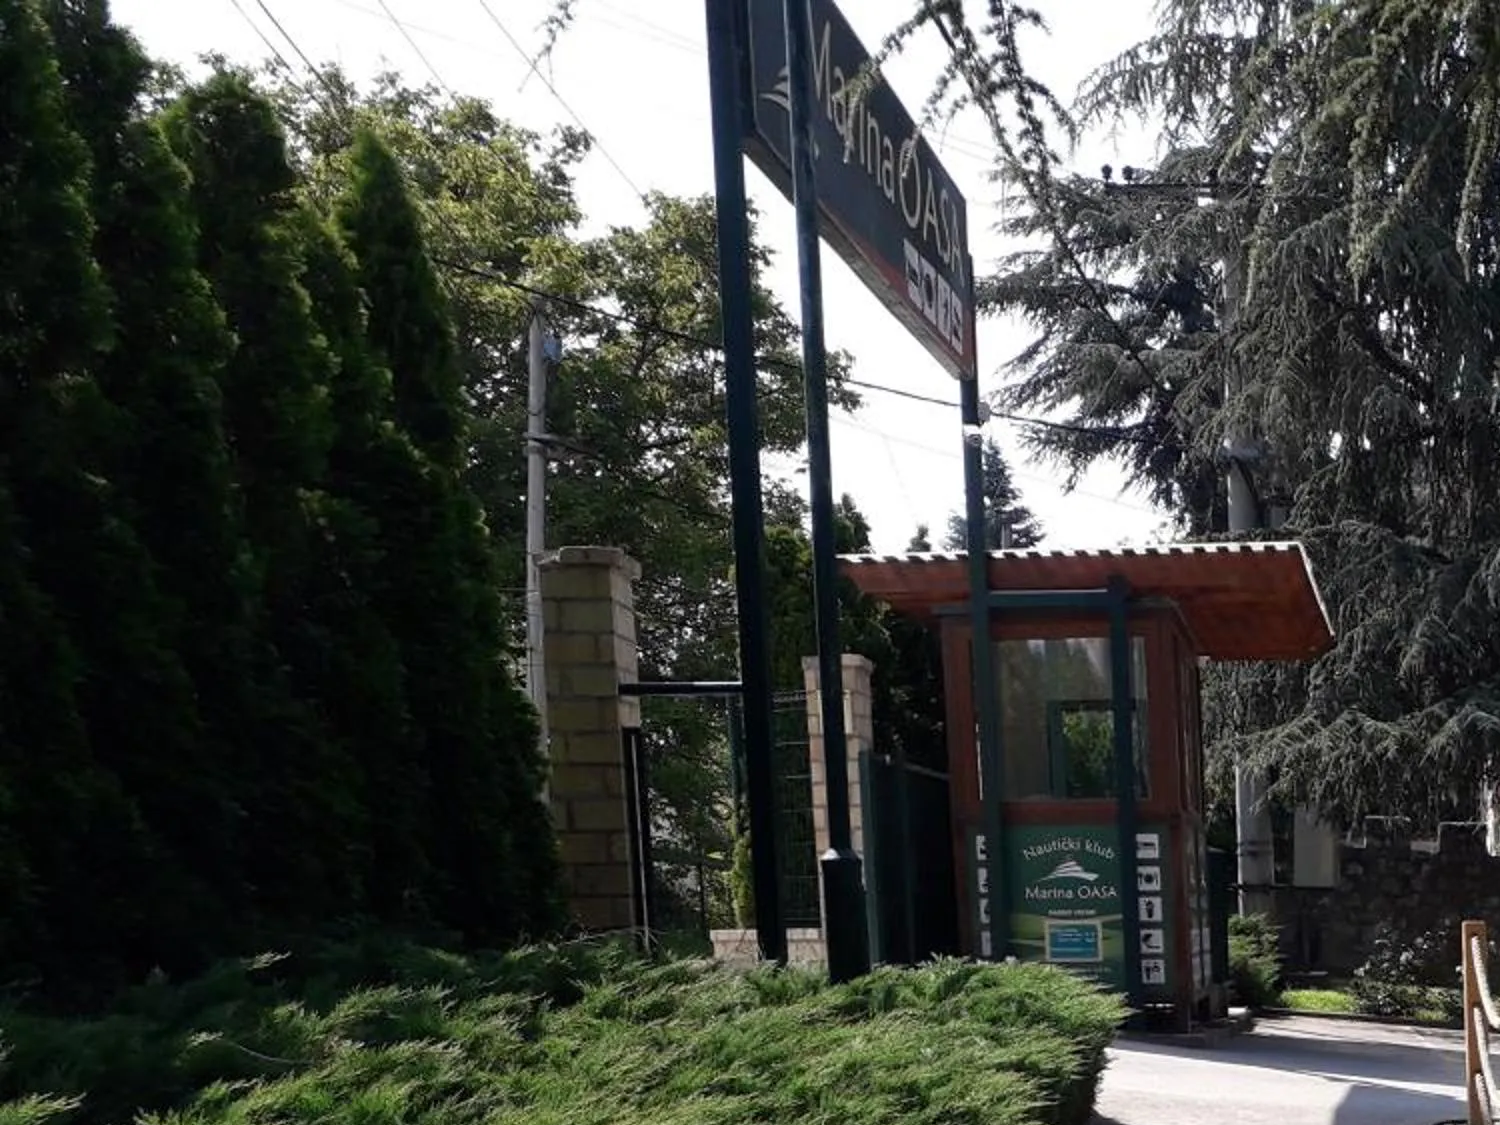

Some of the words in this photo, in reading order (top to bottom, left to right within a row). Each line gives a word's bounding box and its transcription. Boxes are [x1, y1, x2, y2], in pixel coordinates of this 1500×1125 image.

[807, 0, 895, 203] Maina
[900, 138, 965, 287] OASA
[1085, 839, 1115, 859] klub
[1025, 885, 1073, 899] Marina
[1078, 885, 1117, 899] OASA
